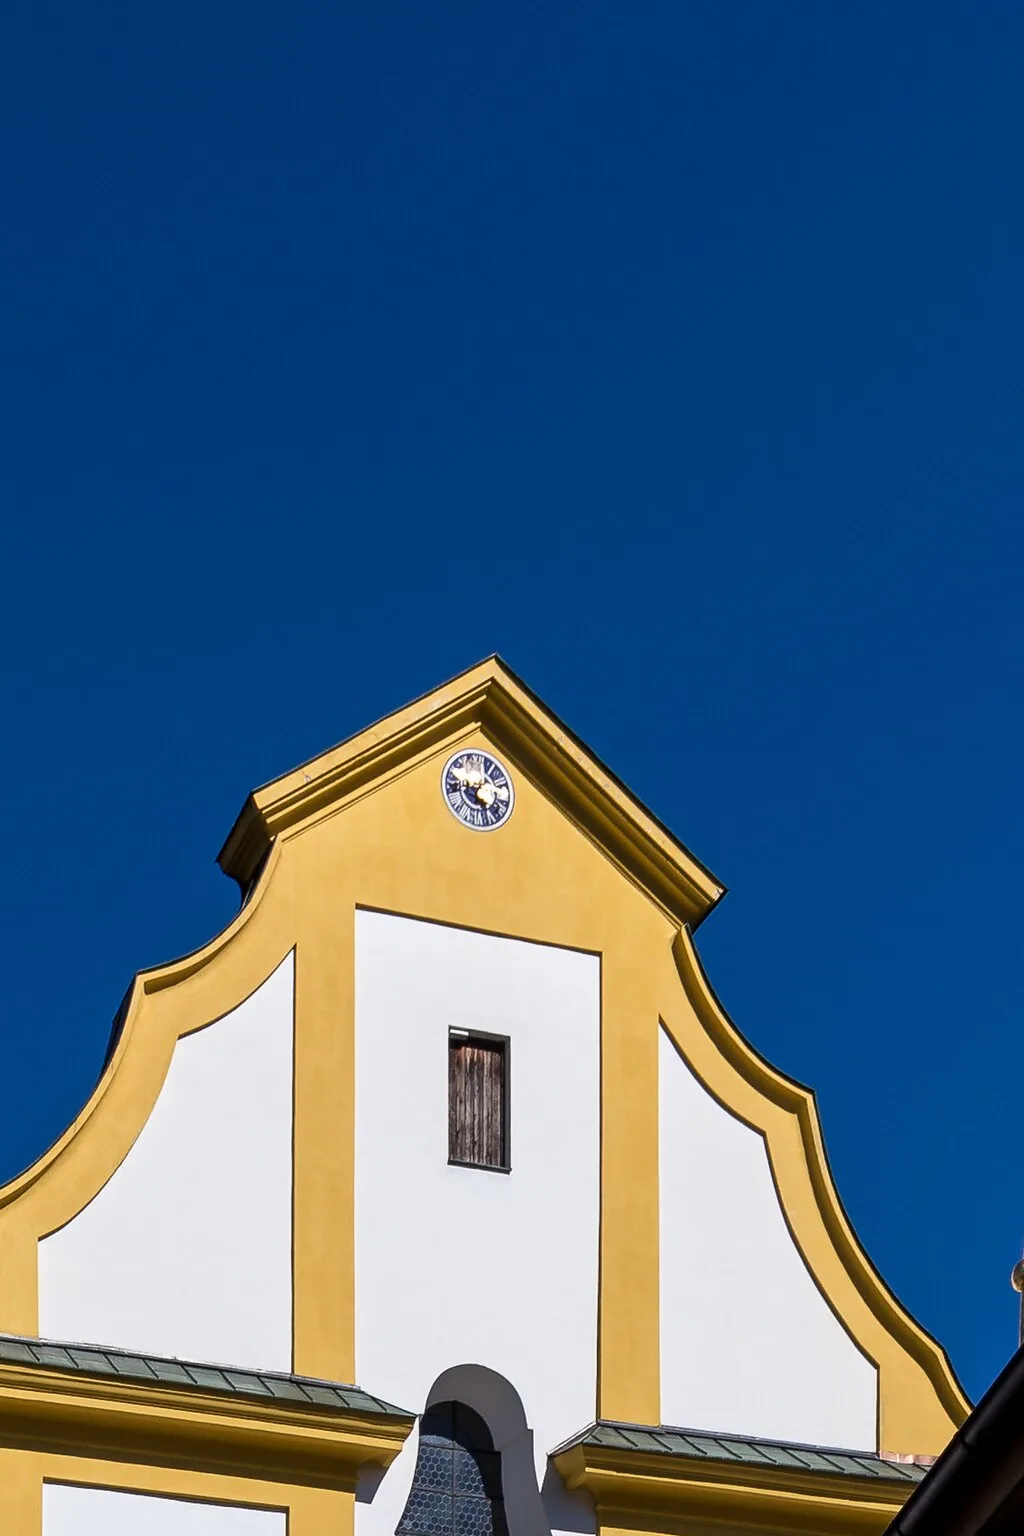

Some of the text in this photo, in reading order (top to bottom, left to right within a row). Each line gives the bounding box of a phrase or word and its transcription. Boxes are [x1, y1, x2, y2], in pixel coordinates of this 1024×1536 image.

[487, 764, 495, 775] I
[494, 777, 506, 786] II
[487, 810, 496, 824] V
